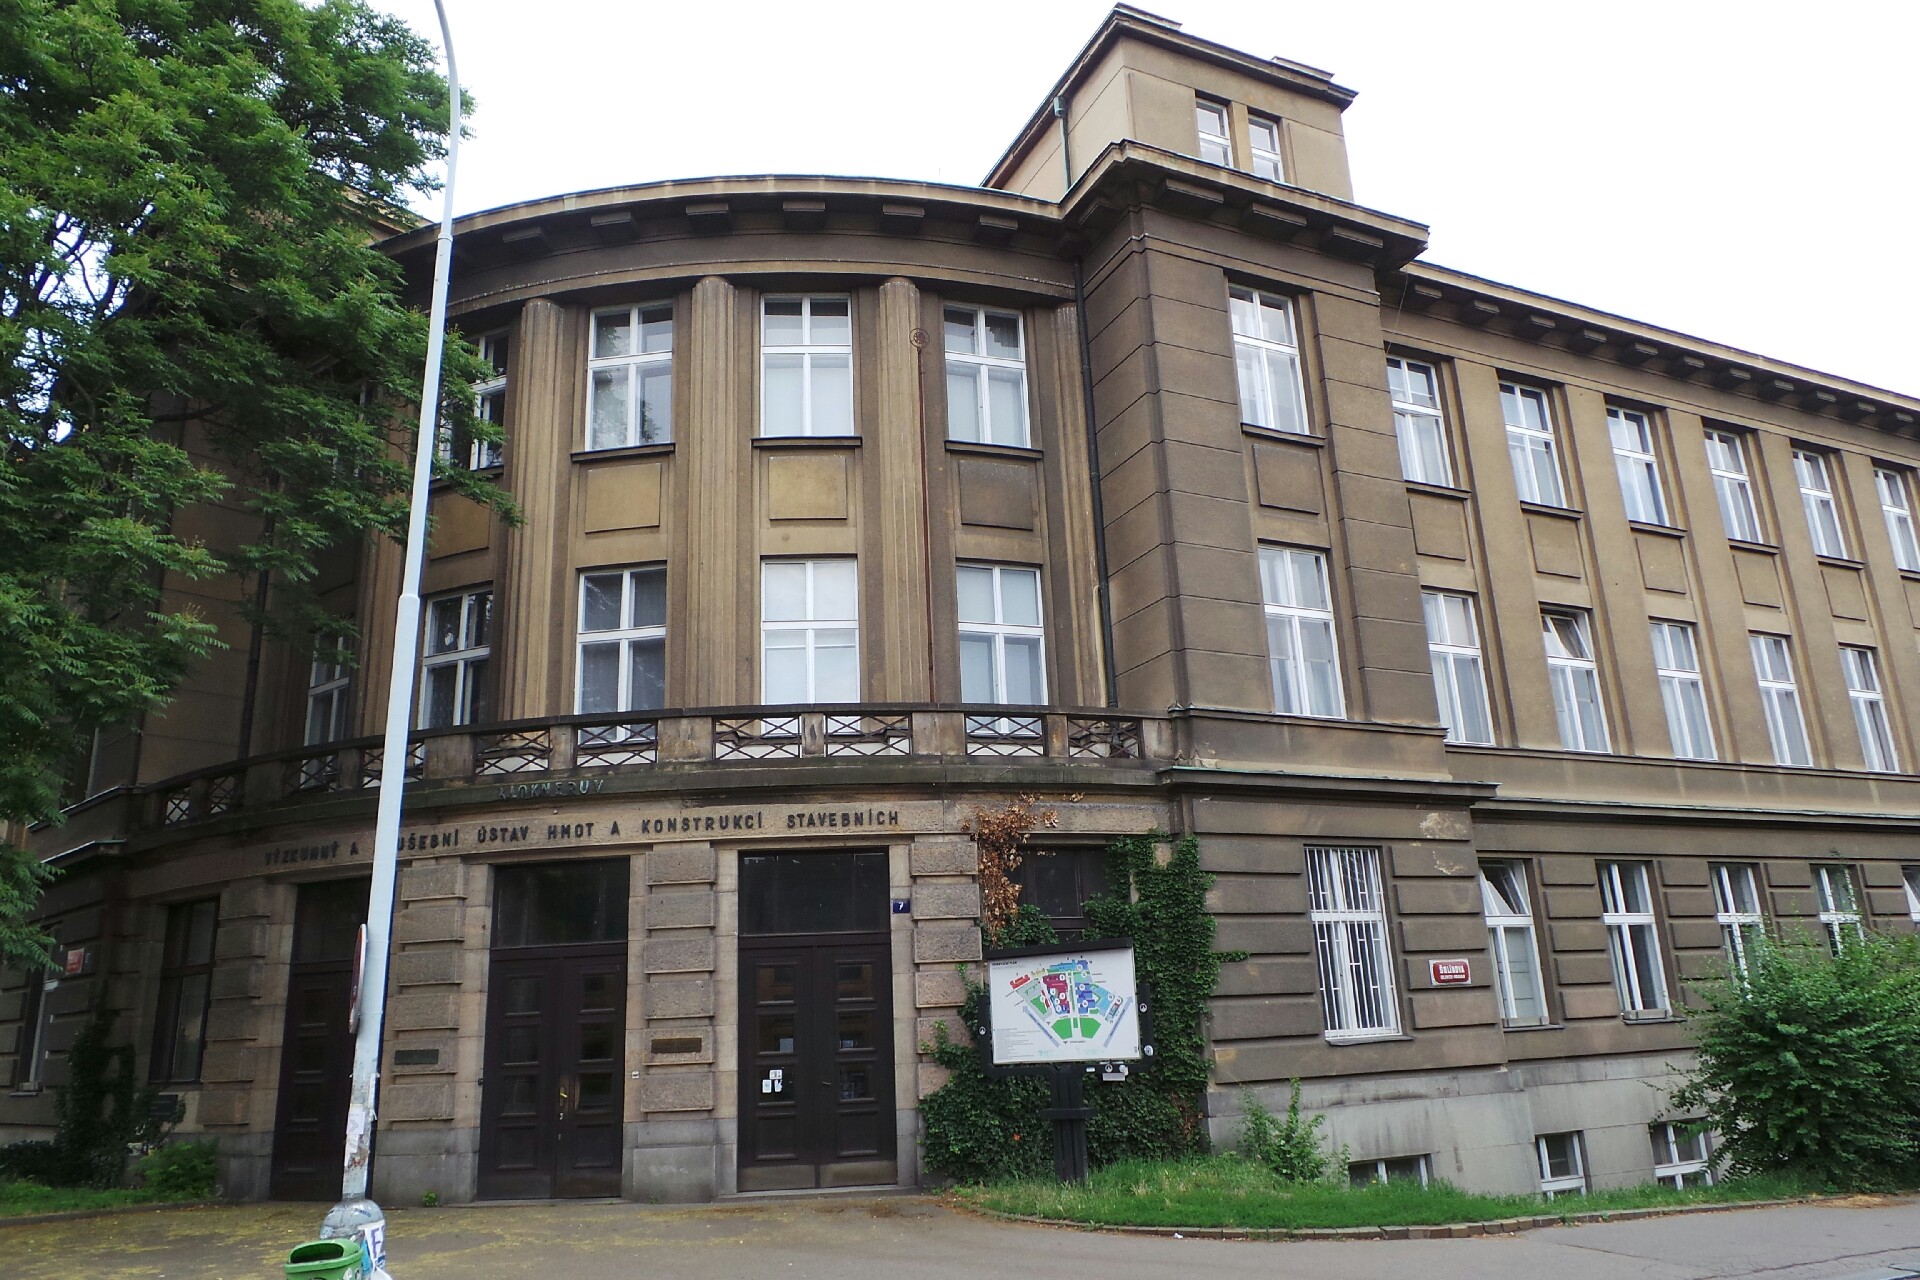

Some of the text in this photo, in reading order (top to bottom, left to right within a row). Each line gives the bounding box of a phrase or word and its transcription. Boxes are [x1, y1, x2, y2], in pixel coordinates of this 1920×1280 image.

[349, 841, 358, 856] A
[374, 829, 458, 850] UŠEBNÍ
[478, 826, 528, 843] ÚSTAV
[547, 823, 594, 839] HMOT
[610, 821, 620, 836] A
[641, 811, 762, 833] KONSTRUKCÍ
[787, 808, 898, 828] STAVEBNÍCH
[898, 901, 904, 911] 7
